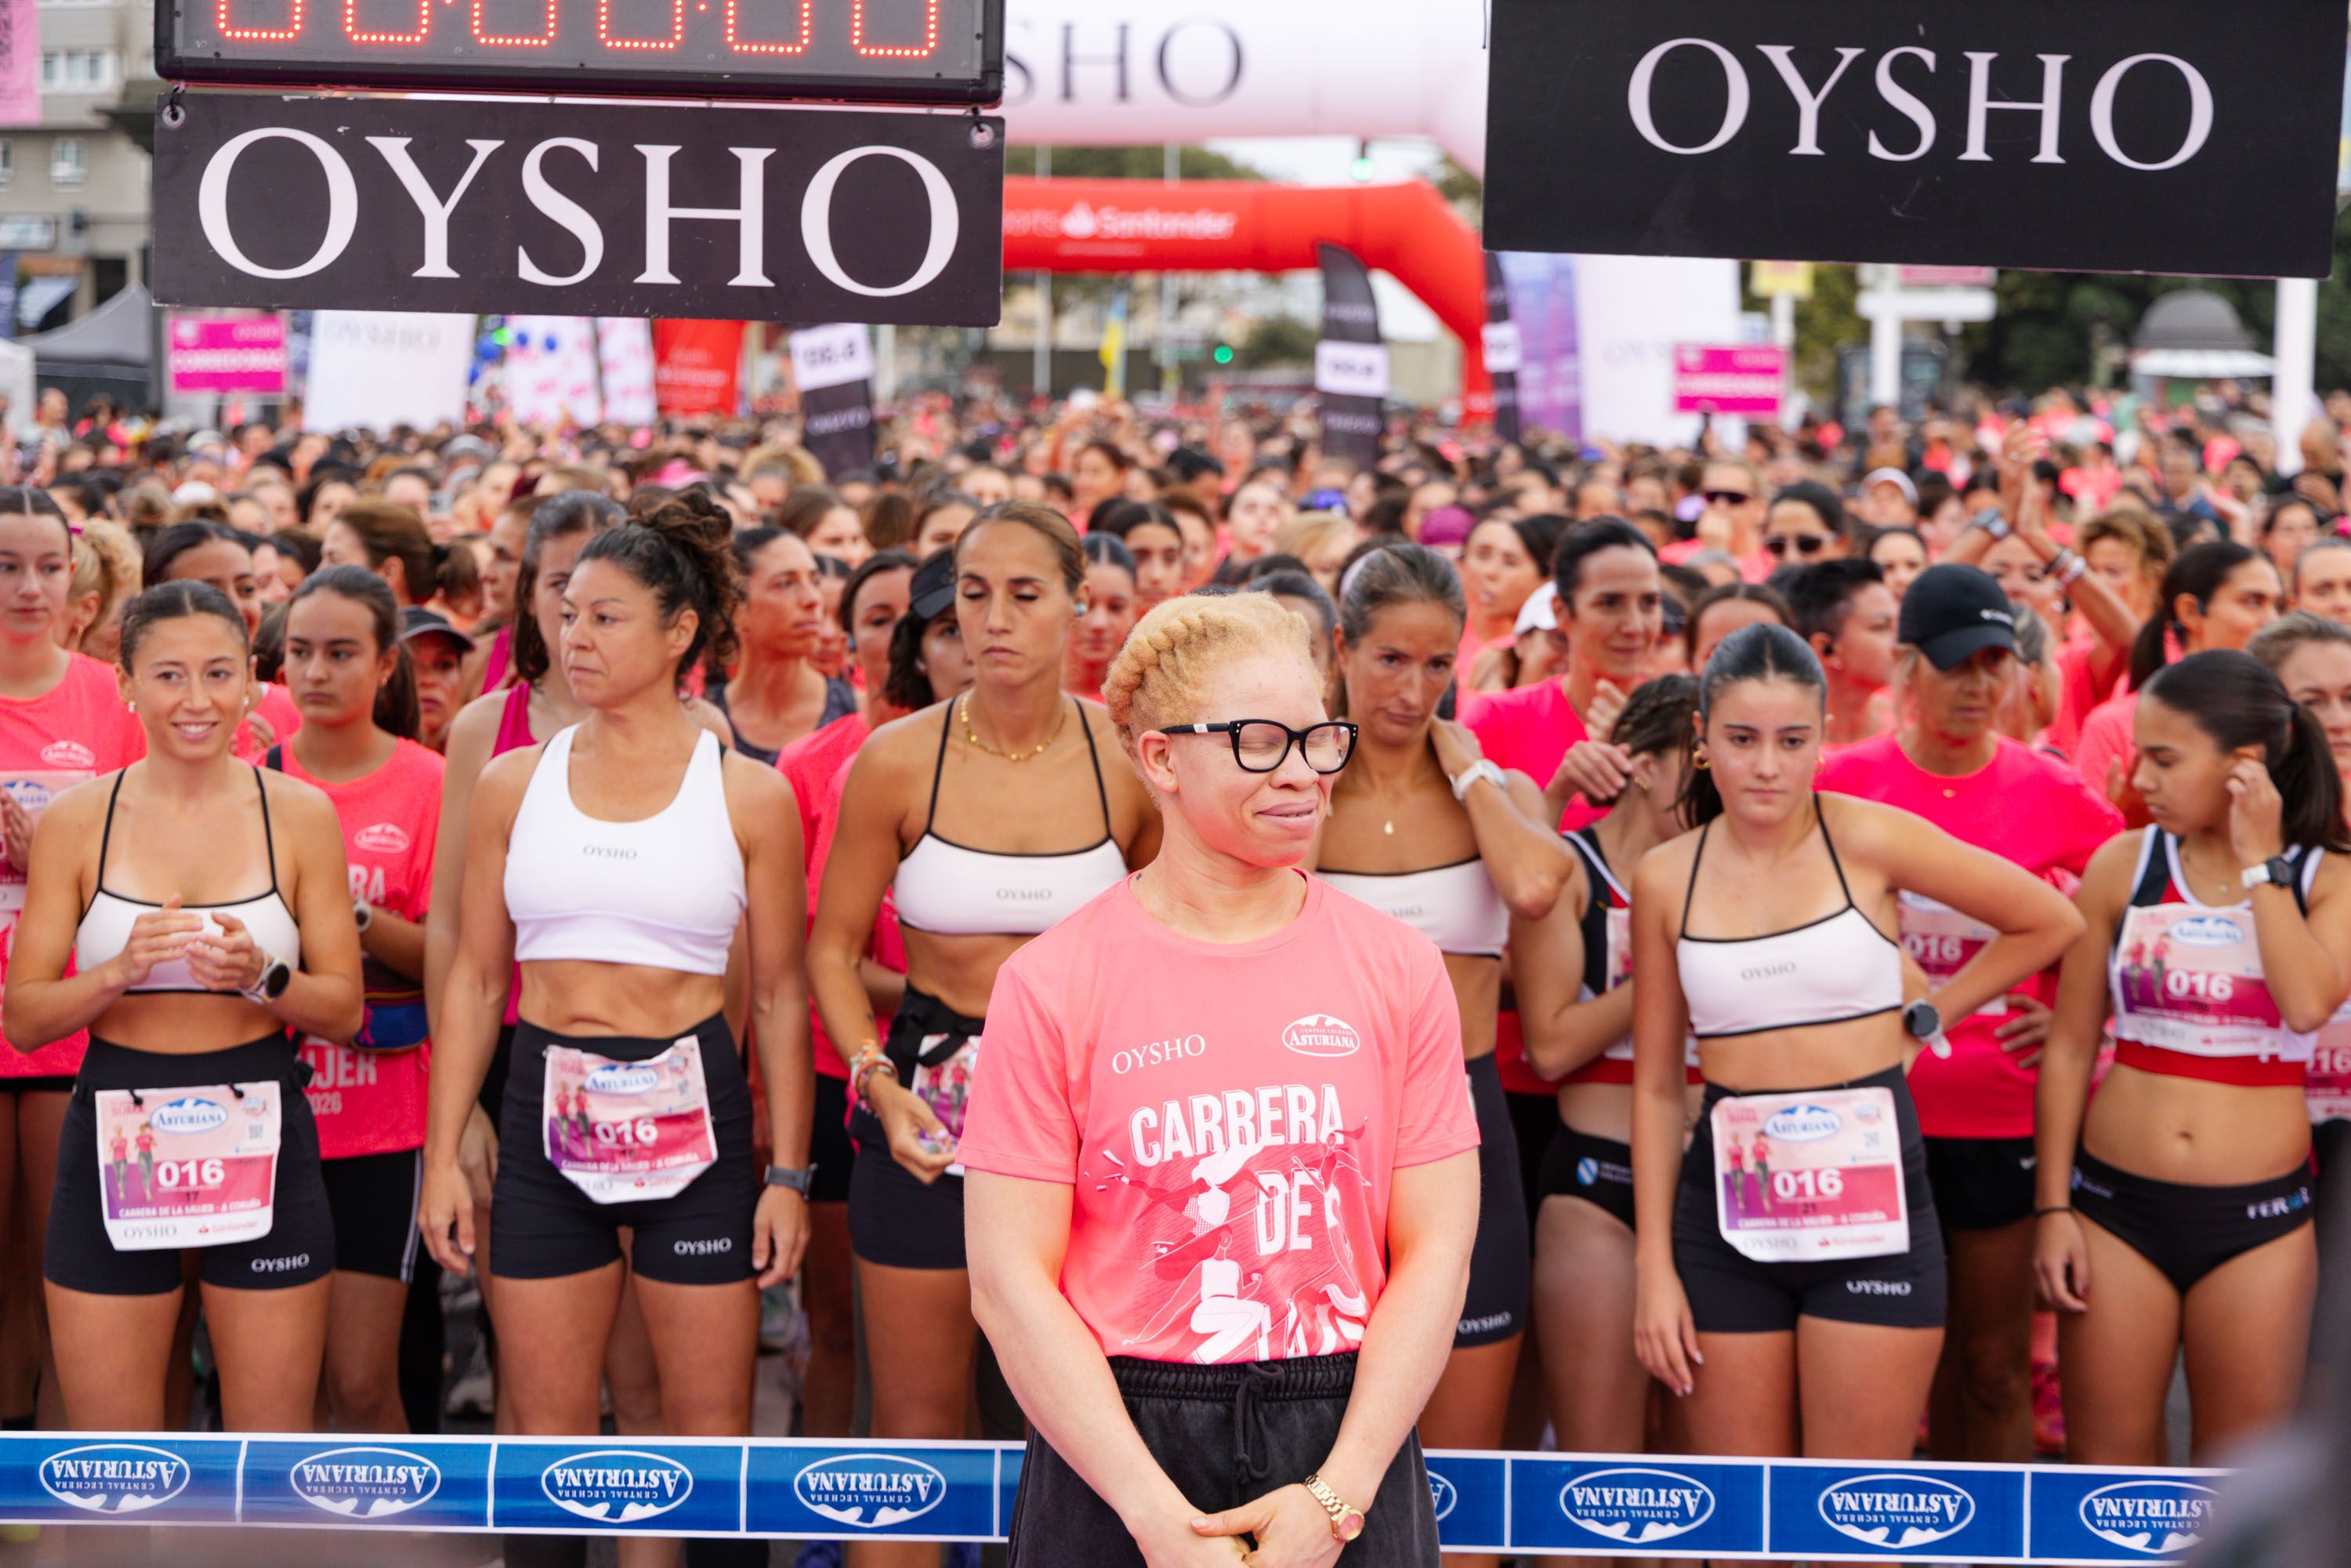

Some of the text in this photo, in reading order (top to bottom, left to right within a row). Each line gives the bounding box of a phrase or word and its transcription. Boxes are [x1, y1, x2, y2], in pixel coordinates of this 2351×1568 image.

[1628, 38, 2215, 170] OYSHO
[198, 126, 960, 297] OYSHO
[583, 845, 637, 860] OYSHO
[996, 888, 1052, 901] OYSHO
[1904, 933, 1962, 962] 016
[1741, 961, 1797, 980] OYSHO
[2168, 969, 2233, 1001] 016
[1290, 1030, 1355, 1048] ASTURIANA
[1112, 1034, 1206, 1074] OYSHO
[589, 1076, 654, 1090] ASTURIANA
[156, 1112, 223, 1128] ASTURIANA
[1129, 1083, 1346, 1168] CARRERA
[596, 1117, 658, 1145] 016
[158, 1159, 226, 1187] 016
[1774, 1168, 1844, 1197] 016
[119, 1206, 158, 1219] CARRERA
[159, 1205, 170, 1216] DE
[172, 1204, 184, 1216] LA
[1254, 1168, 1321, 1256] DE
[124, 1224, 177, 1240] OYSHO
[674, 1237, 732, 1256] OYSHO
[251, 1252, 310, 1273] OYSHO
[1846, 1278, 1912, 1297] OYSHO
[1458, 1310, 1512, 1335] OYSHO
[52, 1460, 179, 1490] ASTURIANA
[55, 1481, 103, 1490] LECHERA
[302, 1465, 430, 1494] ASTURIANA
[553, 1468, 683, 1498] ASTURIANA
[306, 1486, 407, 1495] CENTRAL LECHERA
[558, 1490, 658, 1499] CENTRAL LECHERA
[806, 1472, 935, 1502] ASTURIANA
[810, 1493, 911, 1503] CENTRAL LECHERA
[1571, 1487, 1704, 1518] ASTURIANA
[1831, 1492, 1964, 1523] ASTURIANA
[1576, 1508, 1679, 1519] CENTRAL LECHERA
[1835, 1513, 1940, 1524] CENTRAL LECHERA
[2096, 1519, 2200, 1528] CENTRAL LECHERA
